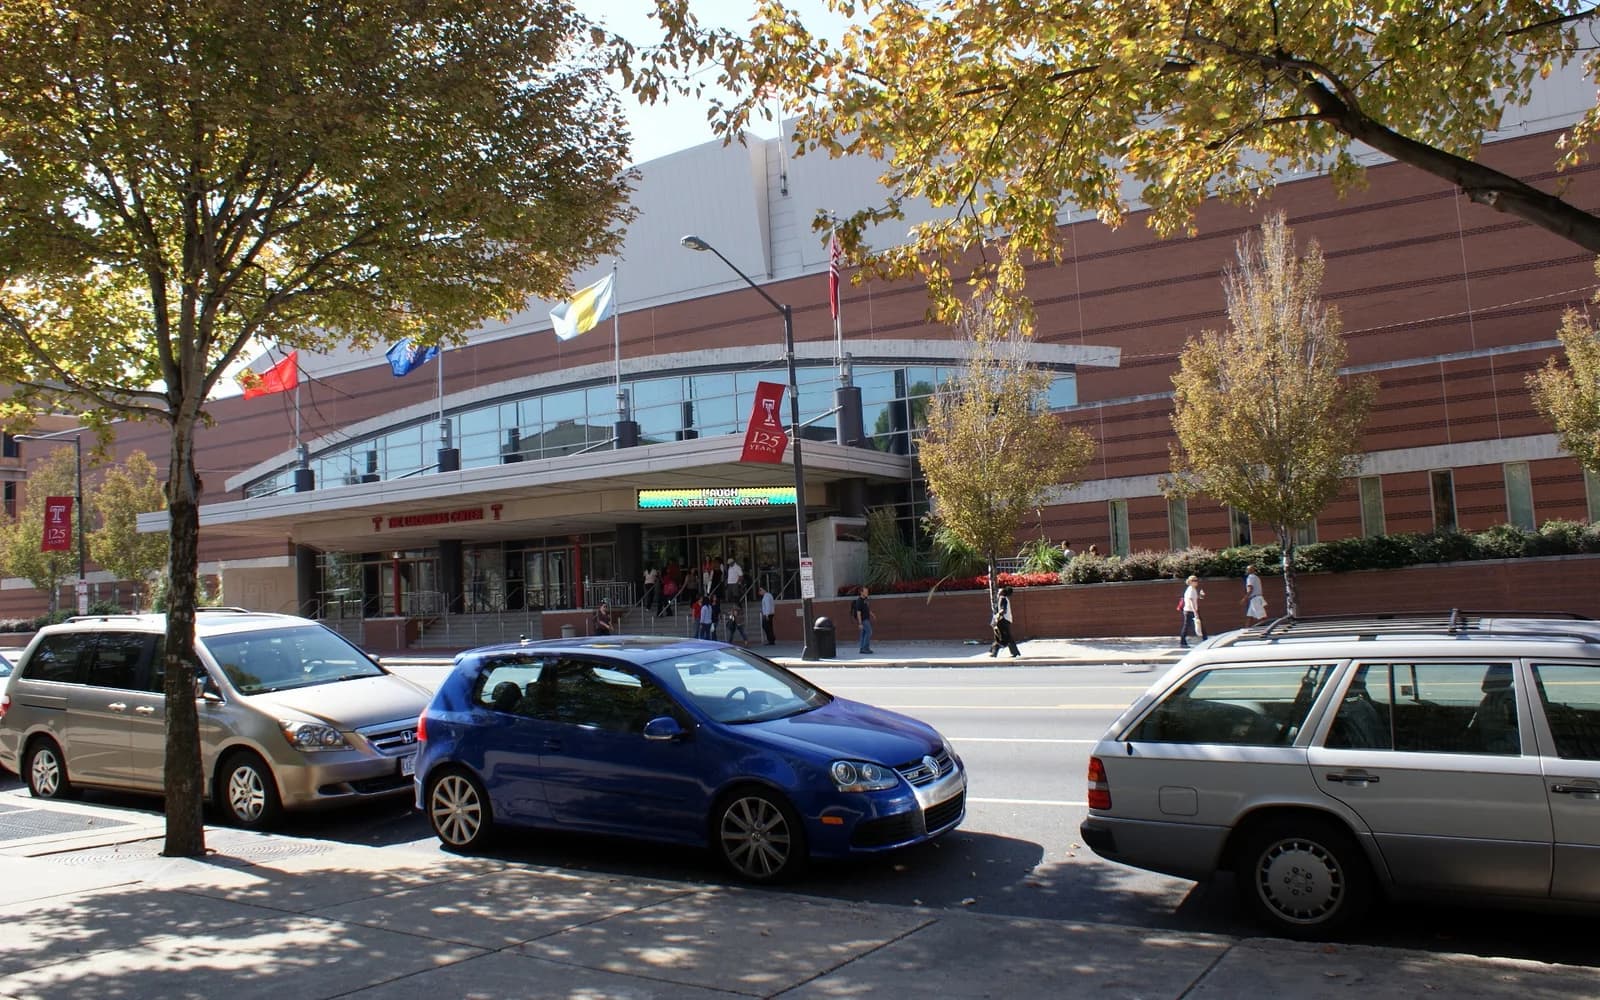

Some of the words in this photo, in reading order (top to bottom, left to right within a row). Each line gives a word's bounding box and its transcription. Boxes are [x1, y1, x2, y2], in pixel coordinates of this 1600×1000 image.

[763, 399, 775, 426] T
[752, 431, 781, 448] 125
[750, 444, 777, 454] YEARS
[703, 488, 738, 497] LAUGH
[673, 499, 684, 507] TO
[688, 498, 709, 507] KEEP
[714, 498, 736, 507] FROM
[740, 497, 769, 506] CRYING
[50, 505, 66, 523] T
[491, 503, 503, 520] T
[48, 528, 66, 539] 125
